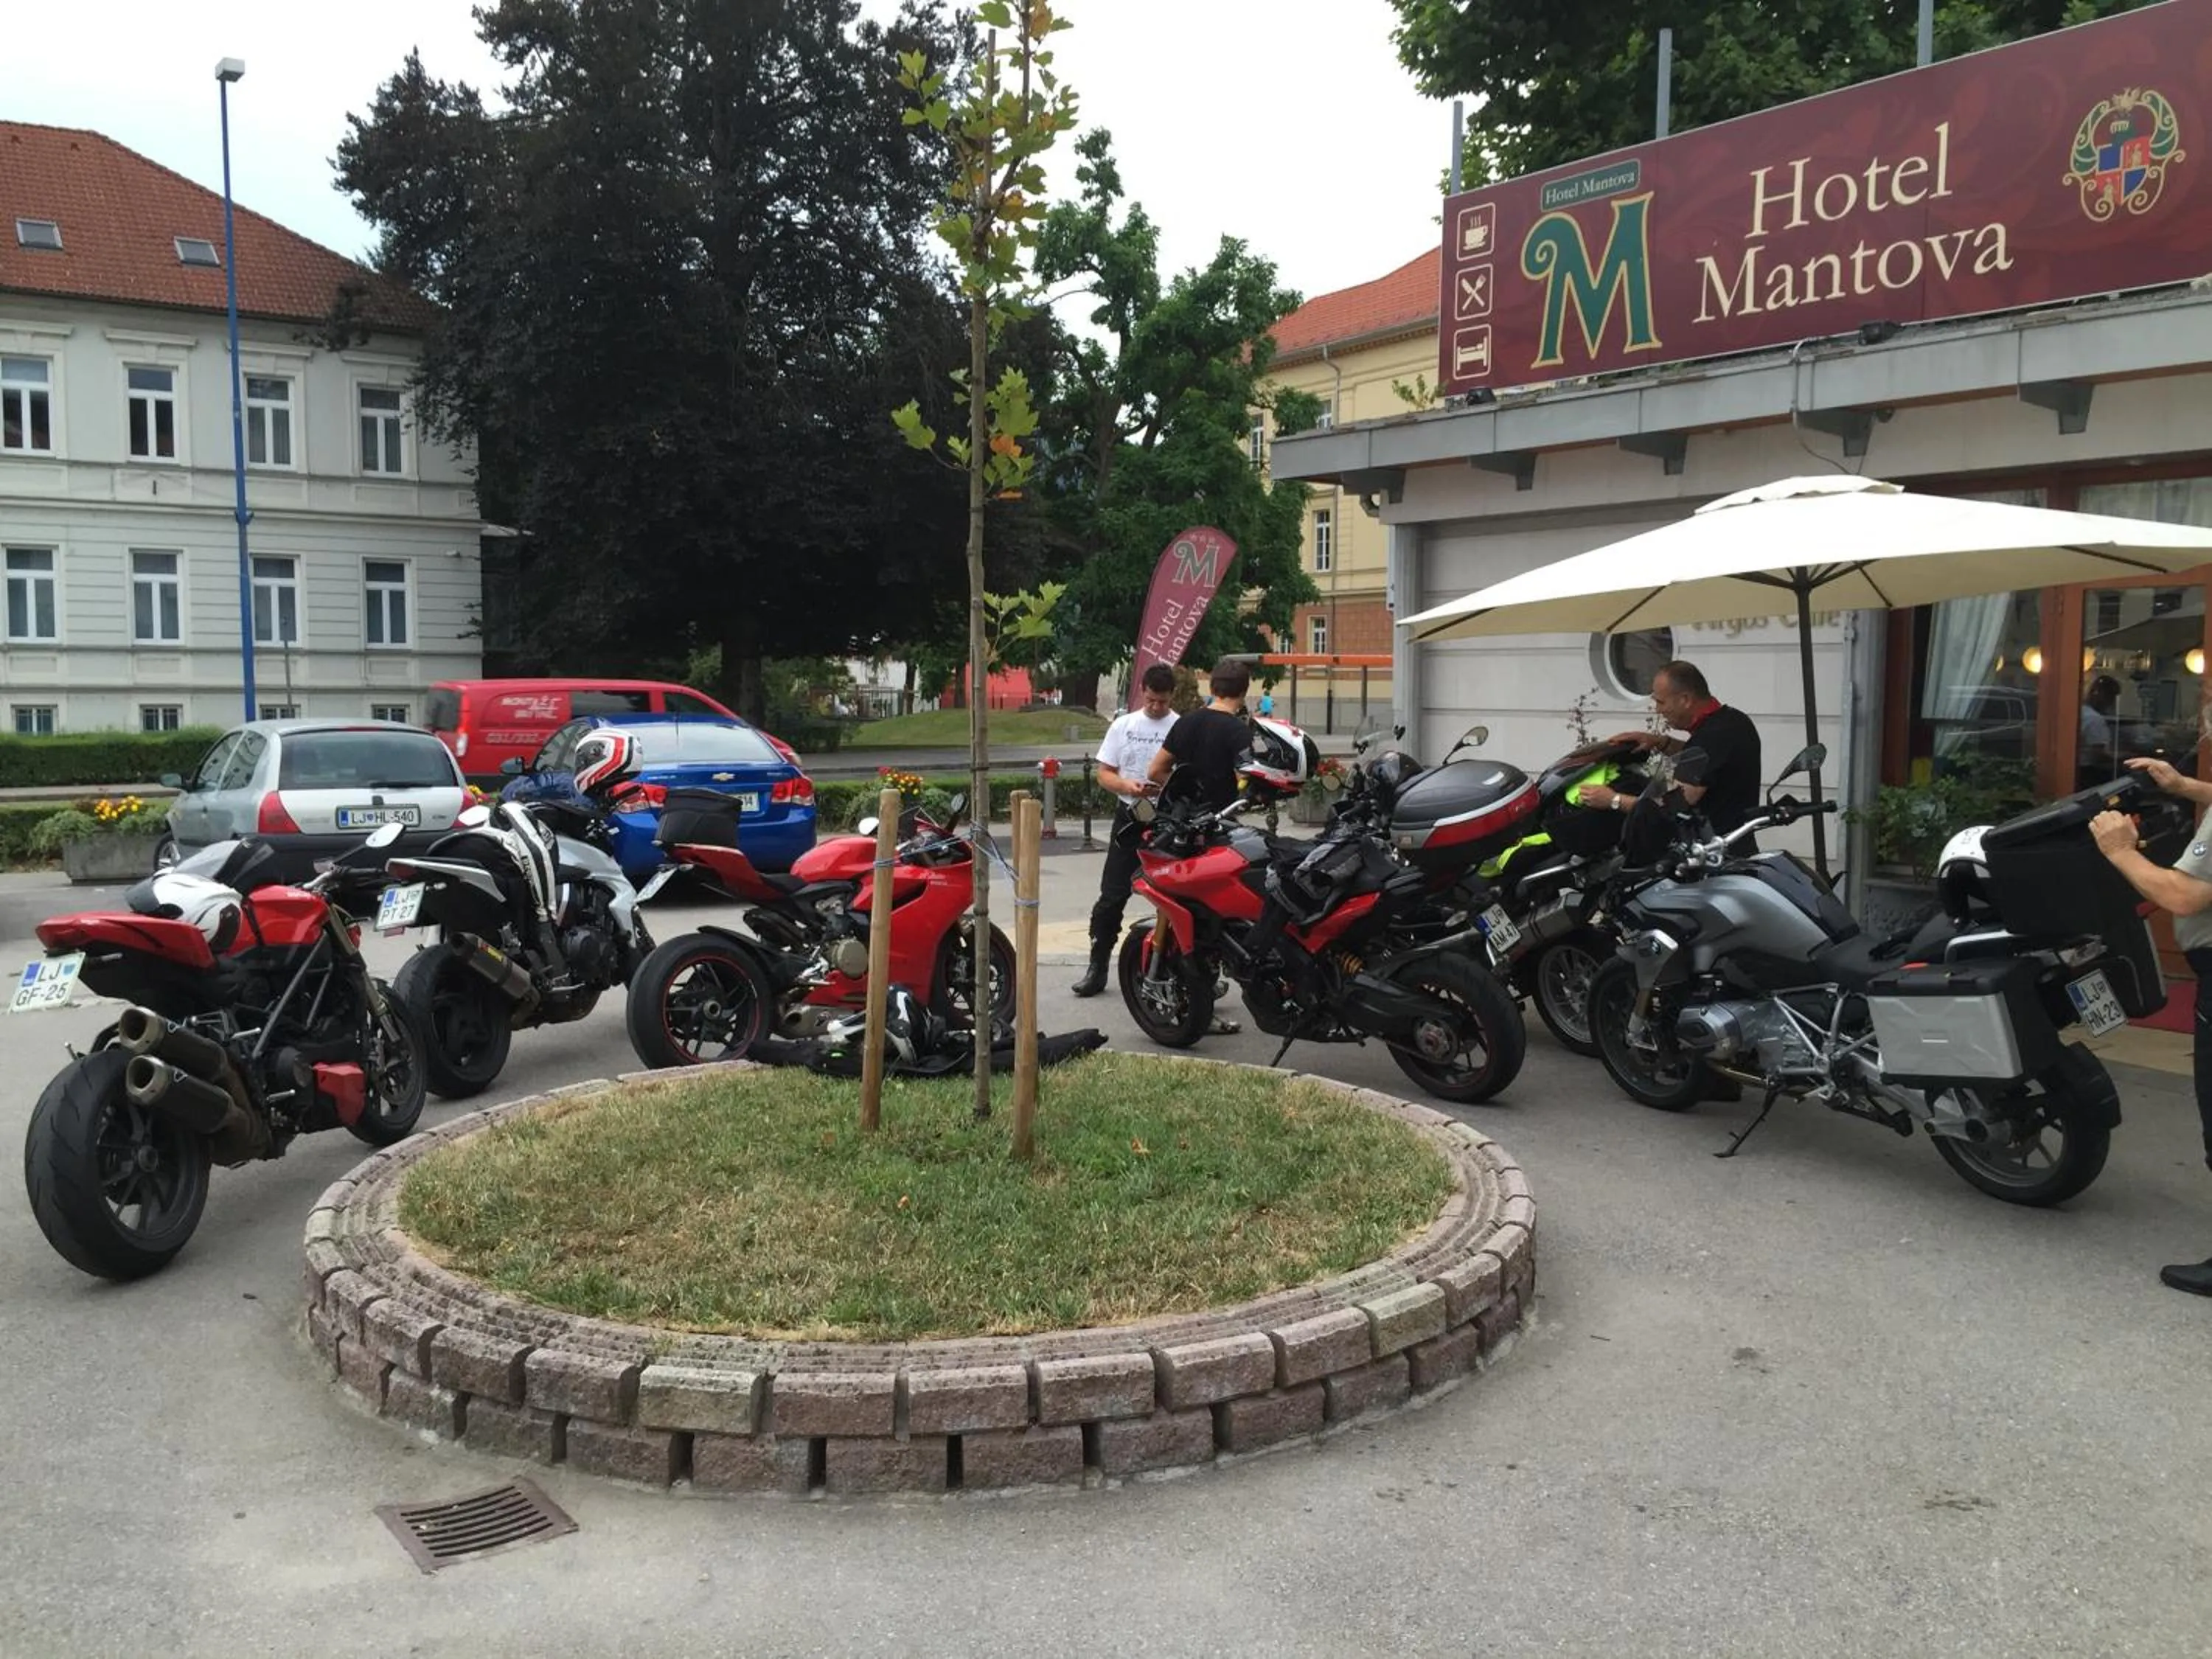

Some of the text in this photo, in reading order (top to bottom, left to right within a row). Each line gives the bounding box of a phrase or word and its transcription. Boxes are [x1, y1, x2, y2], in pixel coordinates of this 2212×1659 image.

[1545, 170, 1636, 205] Hotel Mantova
[1745, 121, 1952, 239] Hotel
[1520, 190, 1663, 369] M
[1692, 221, 2014, 324] Mantova
[1172, 540, 1221, 588] M
[1141, 599, 1184, 659] Hotel
[15, 981, 69, 1006] GF-25
[38, 961, 62, 981] LJ
[2081, 981, 2101, 1004] LJ
